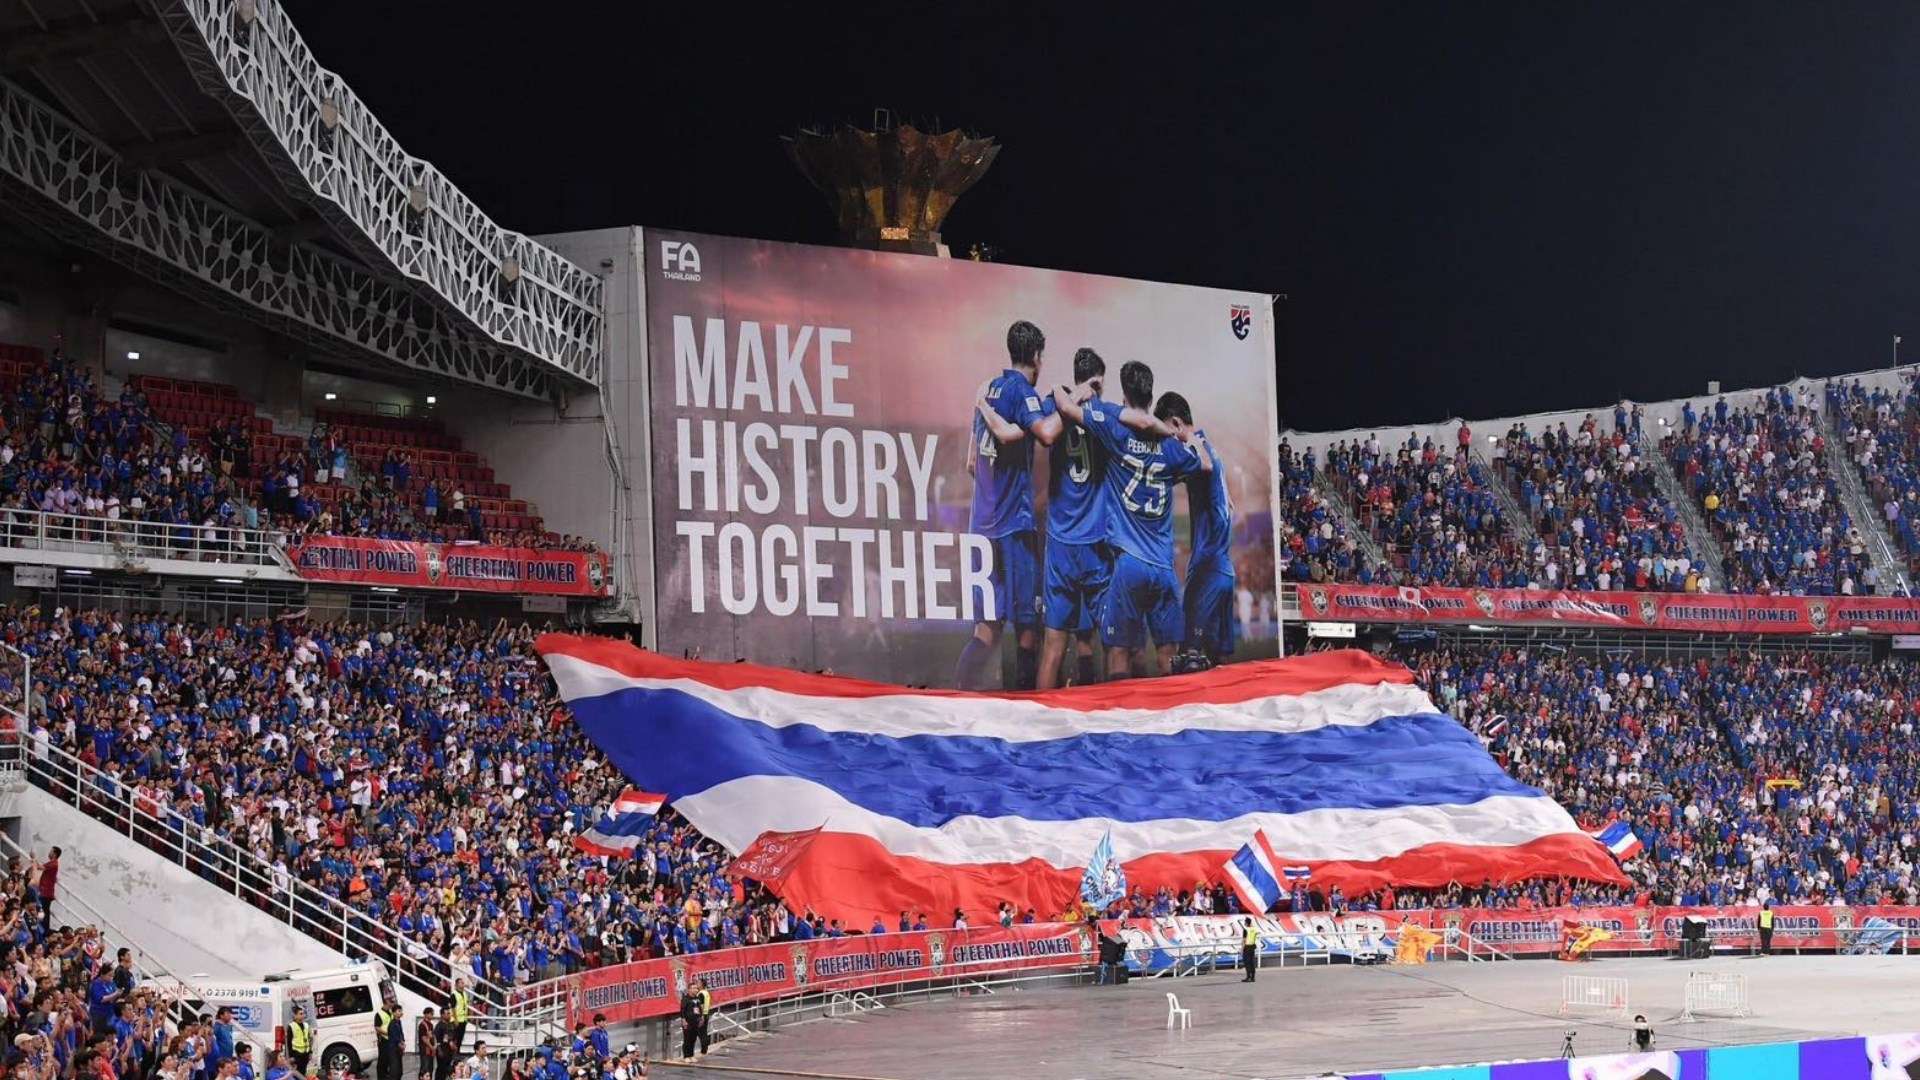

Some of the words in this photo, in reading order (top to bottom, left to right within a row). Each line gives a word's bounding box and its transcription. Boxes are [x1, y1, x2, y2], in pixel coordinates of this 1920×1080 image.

[661, 240, 701, 272] FA
[663, 271, 702, 281] THAILAND
[673, 315, 855, 417] MAKE
[677, 418, 939, 521] HISTORY
[1121, 453, 1169, 516] 25
[365, 550, 418, 573] POWER
[446, 554, 523, 581] CHEERTHAI
[527, 559, 577, 583] POWER
[675, 520, 997, 621] TOGETHER
[1664, 605, 1742, 621] CHEERTHAI
[1747, 608, 1798, 623] POWER
[1838, 608, 1919, 622] CHEERTHAI
[814, 953, 876, 976] CHEERTHAI
[879, 949, 922, 970] POWER
[953, 942, 1025, 963] CHEERTHAI
[1028, 936, 1073, 955] POWER
[747, 962, 786, 983] POWER
[583, 981, 630, 1009] CHEERTHAI
[631, 977, 668, 1000] POWER
